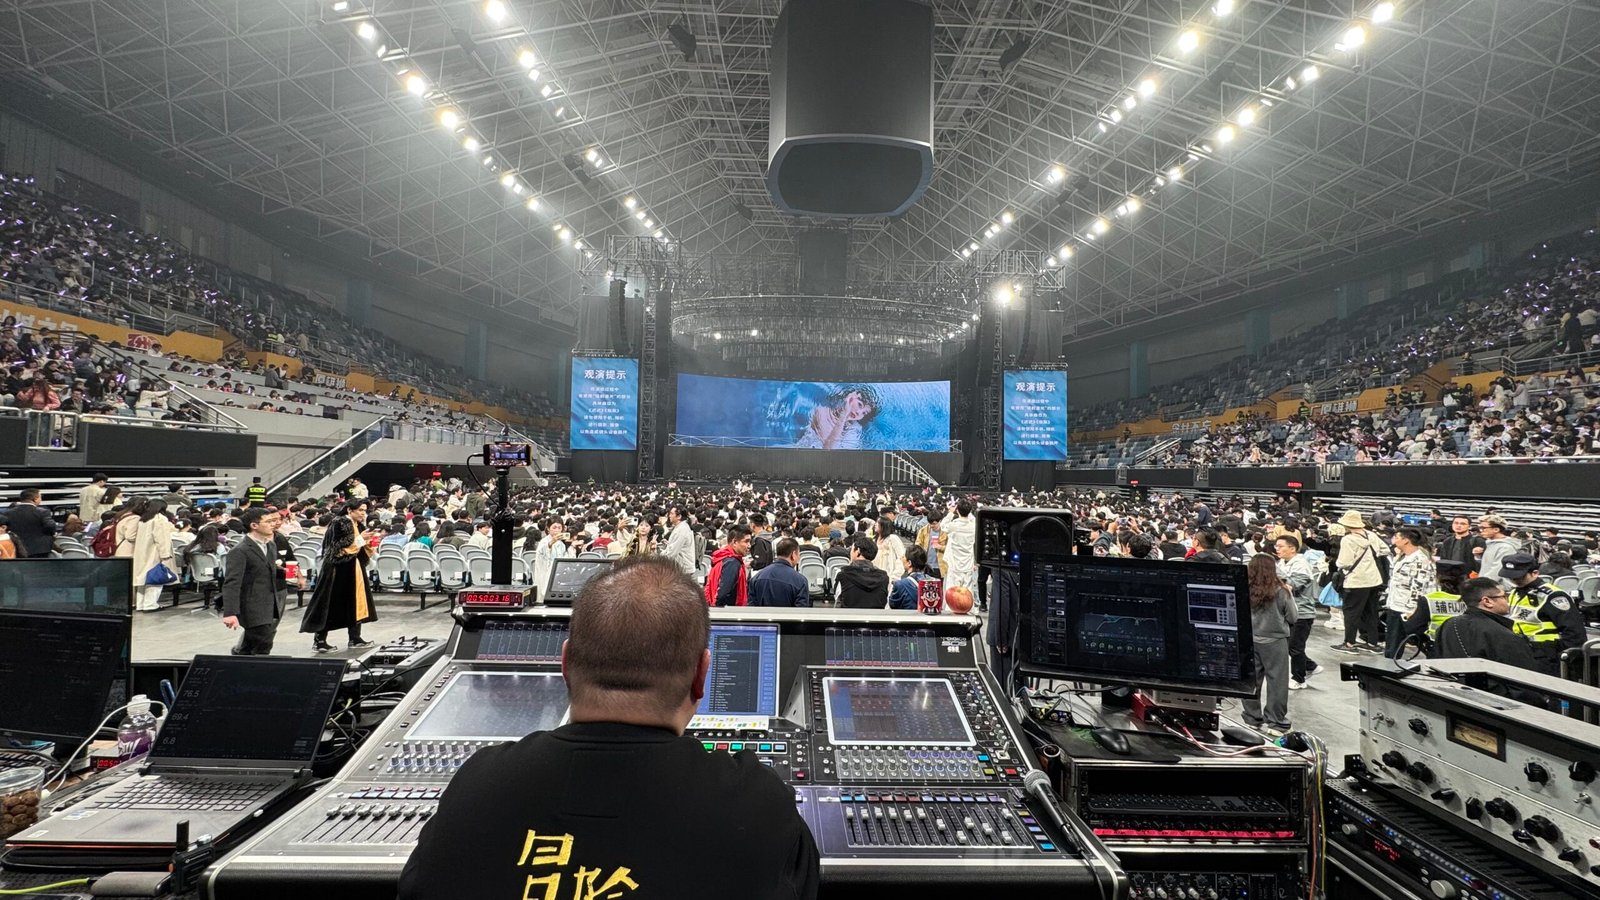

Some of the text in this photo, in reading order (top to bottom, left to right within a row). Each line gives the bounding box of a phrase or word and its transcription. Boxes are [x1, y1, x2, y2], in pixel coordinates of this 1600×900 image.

[584, 369, 626, 380] 观演提示
[1015, 382, 1056, 392] 观演提示
[1435, 601, 1447, 613] 辅
